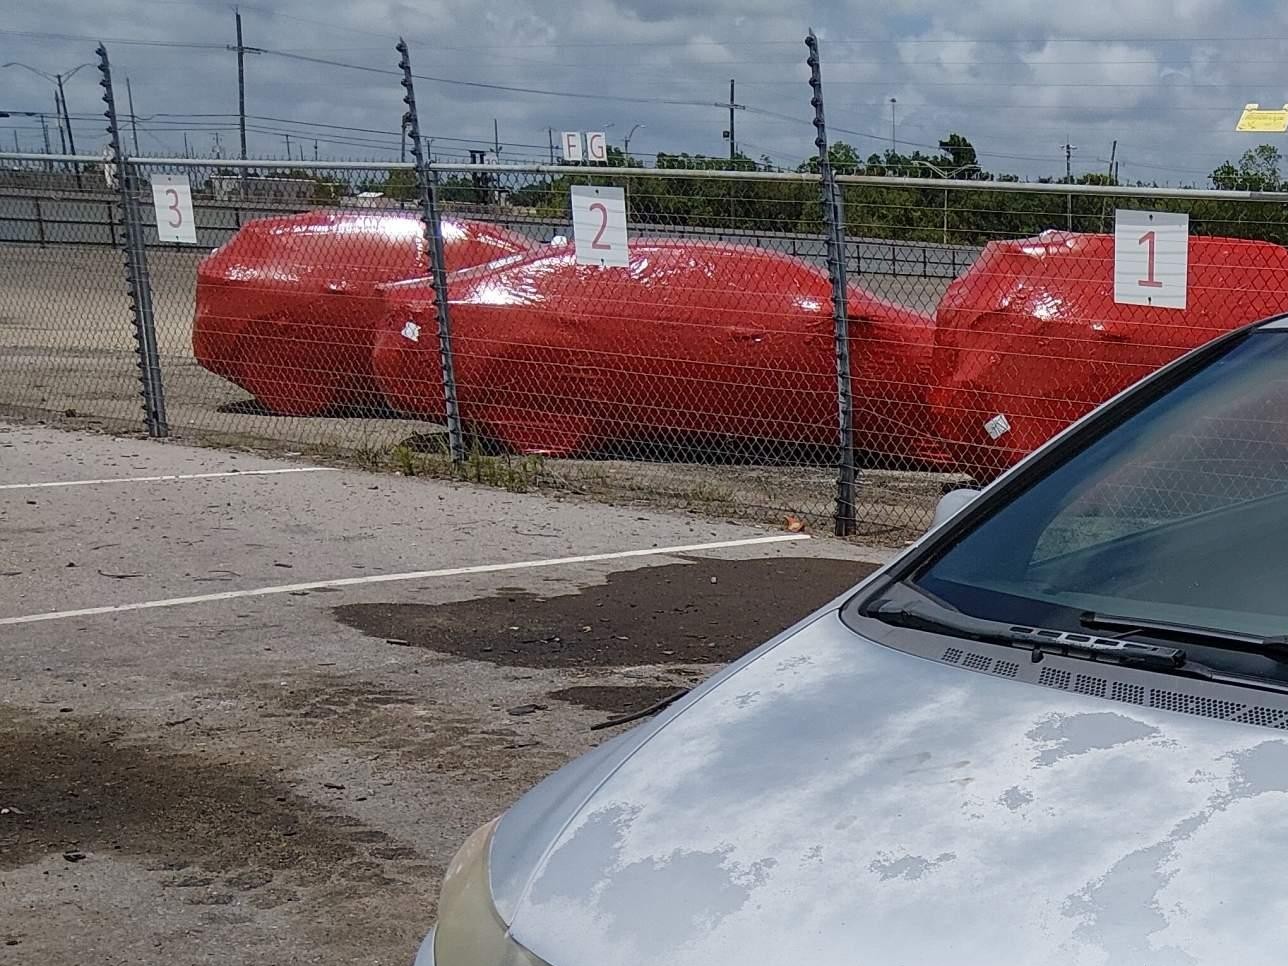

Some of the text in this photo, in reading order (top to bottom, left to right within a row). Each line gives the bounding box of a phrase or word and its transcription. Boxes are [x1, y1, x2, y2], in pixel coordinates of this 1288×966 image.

[566, 133, 605, 160] F G
[166, 188, 184, 230] 3
[588, 202, 612, 251] 2
[1137, 230, 1164, 288] 1
